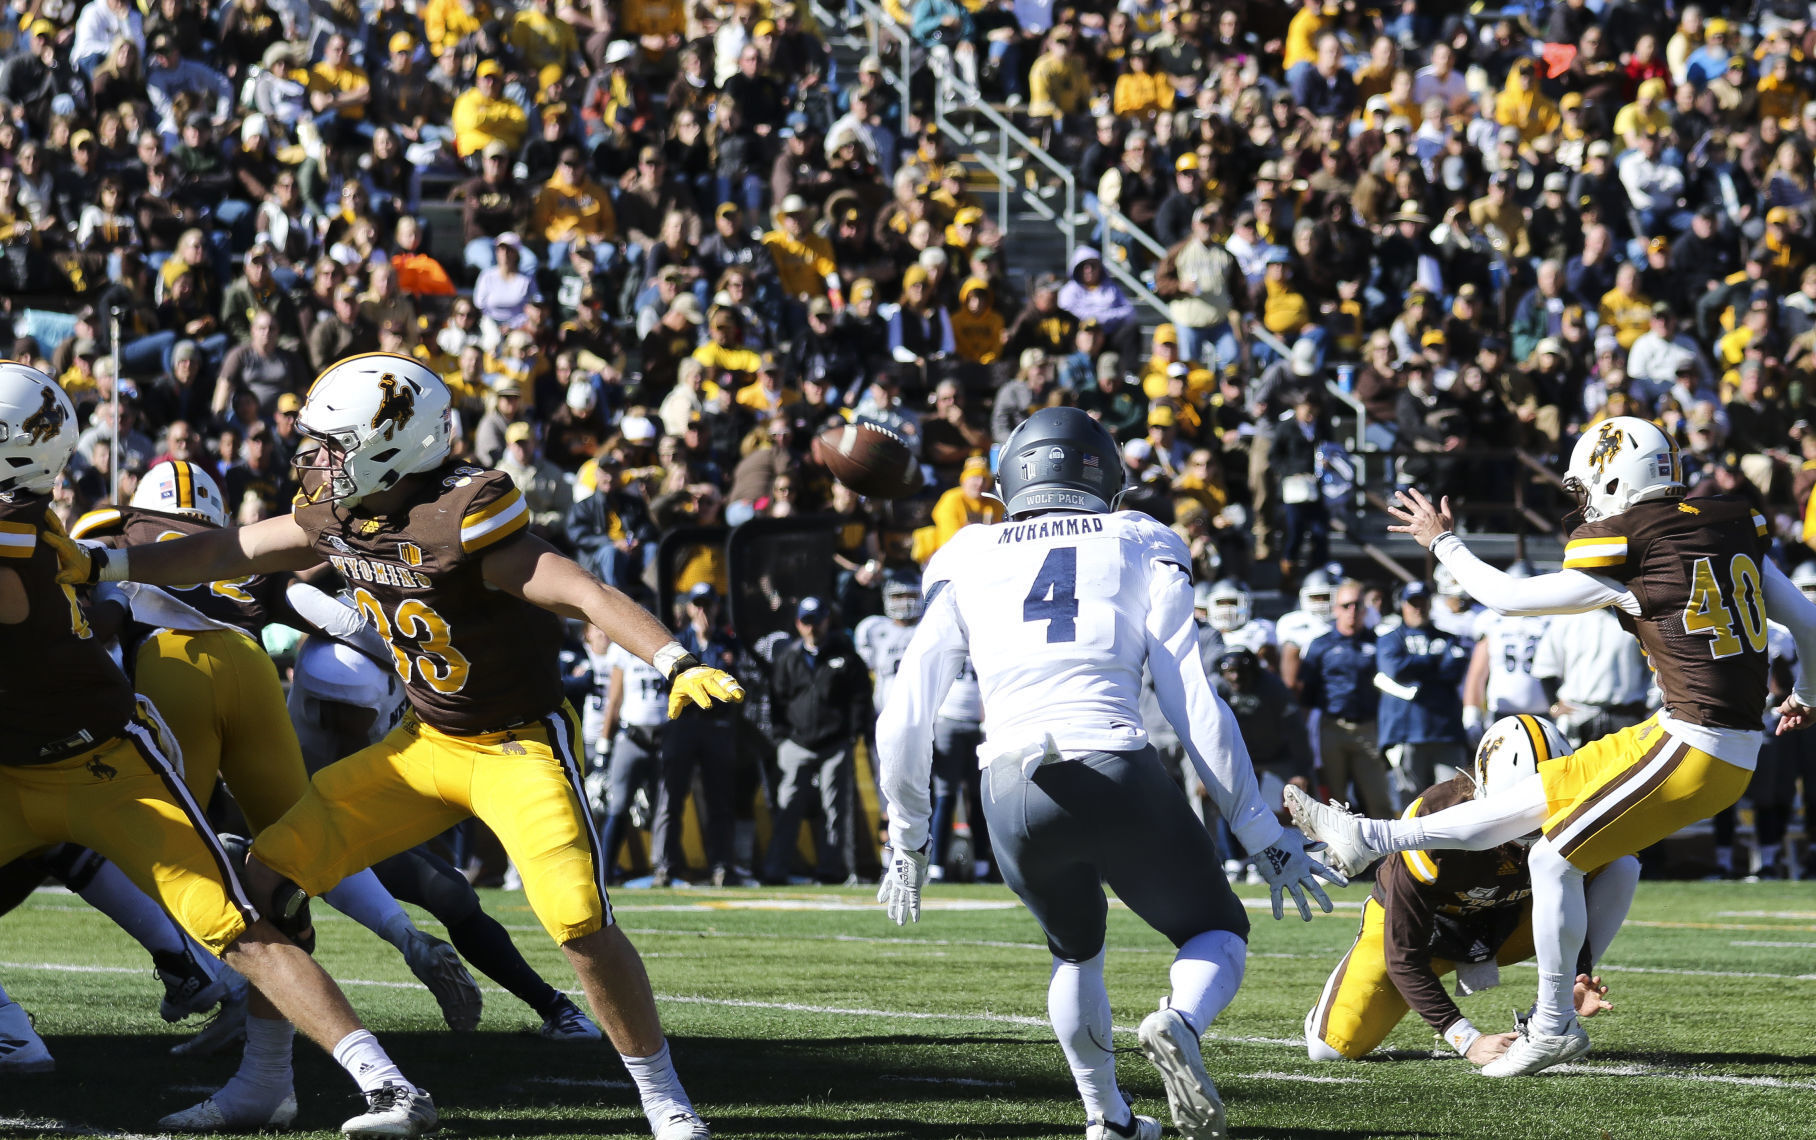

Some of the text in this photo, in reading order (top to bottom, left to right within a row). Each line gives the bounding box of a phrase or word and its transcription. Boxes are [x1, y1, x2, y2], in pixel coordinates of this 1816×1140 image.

[1026, 493, 1085, 505] WOLF PACK
[998, 517, 1104, 544] MUHAMMAD
[1023, 546, 1079, 643] 4
[1682, 553, 1768, 660] 40
